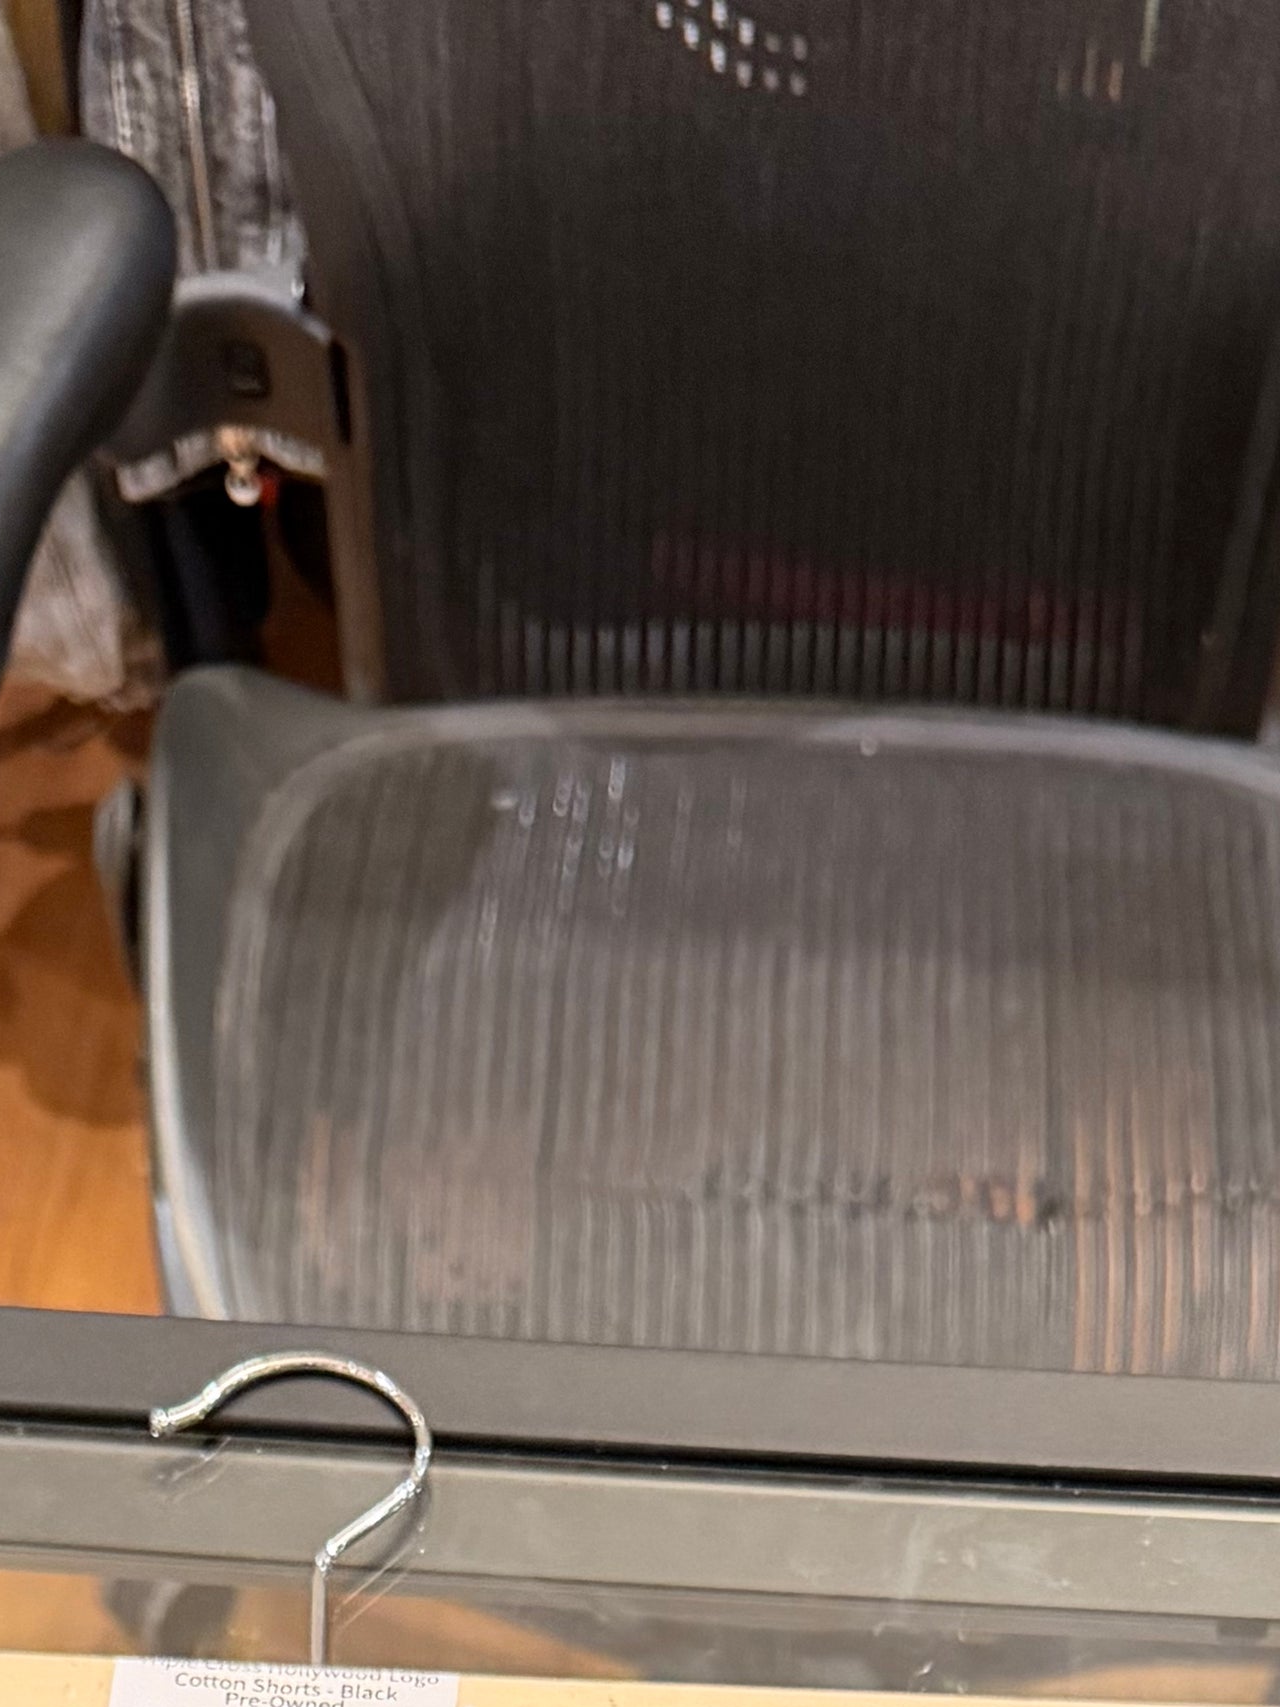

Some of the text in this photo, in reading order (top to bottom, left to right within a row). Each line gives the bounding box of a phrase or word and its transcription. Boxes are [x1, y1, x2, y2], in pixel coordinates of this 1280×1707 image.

[175, 1672, 246, 1691] Cotton
[252, 1678, 320, 1697] Shorts
[341, 1684, 398, 1701] Black
